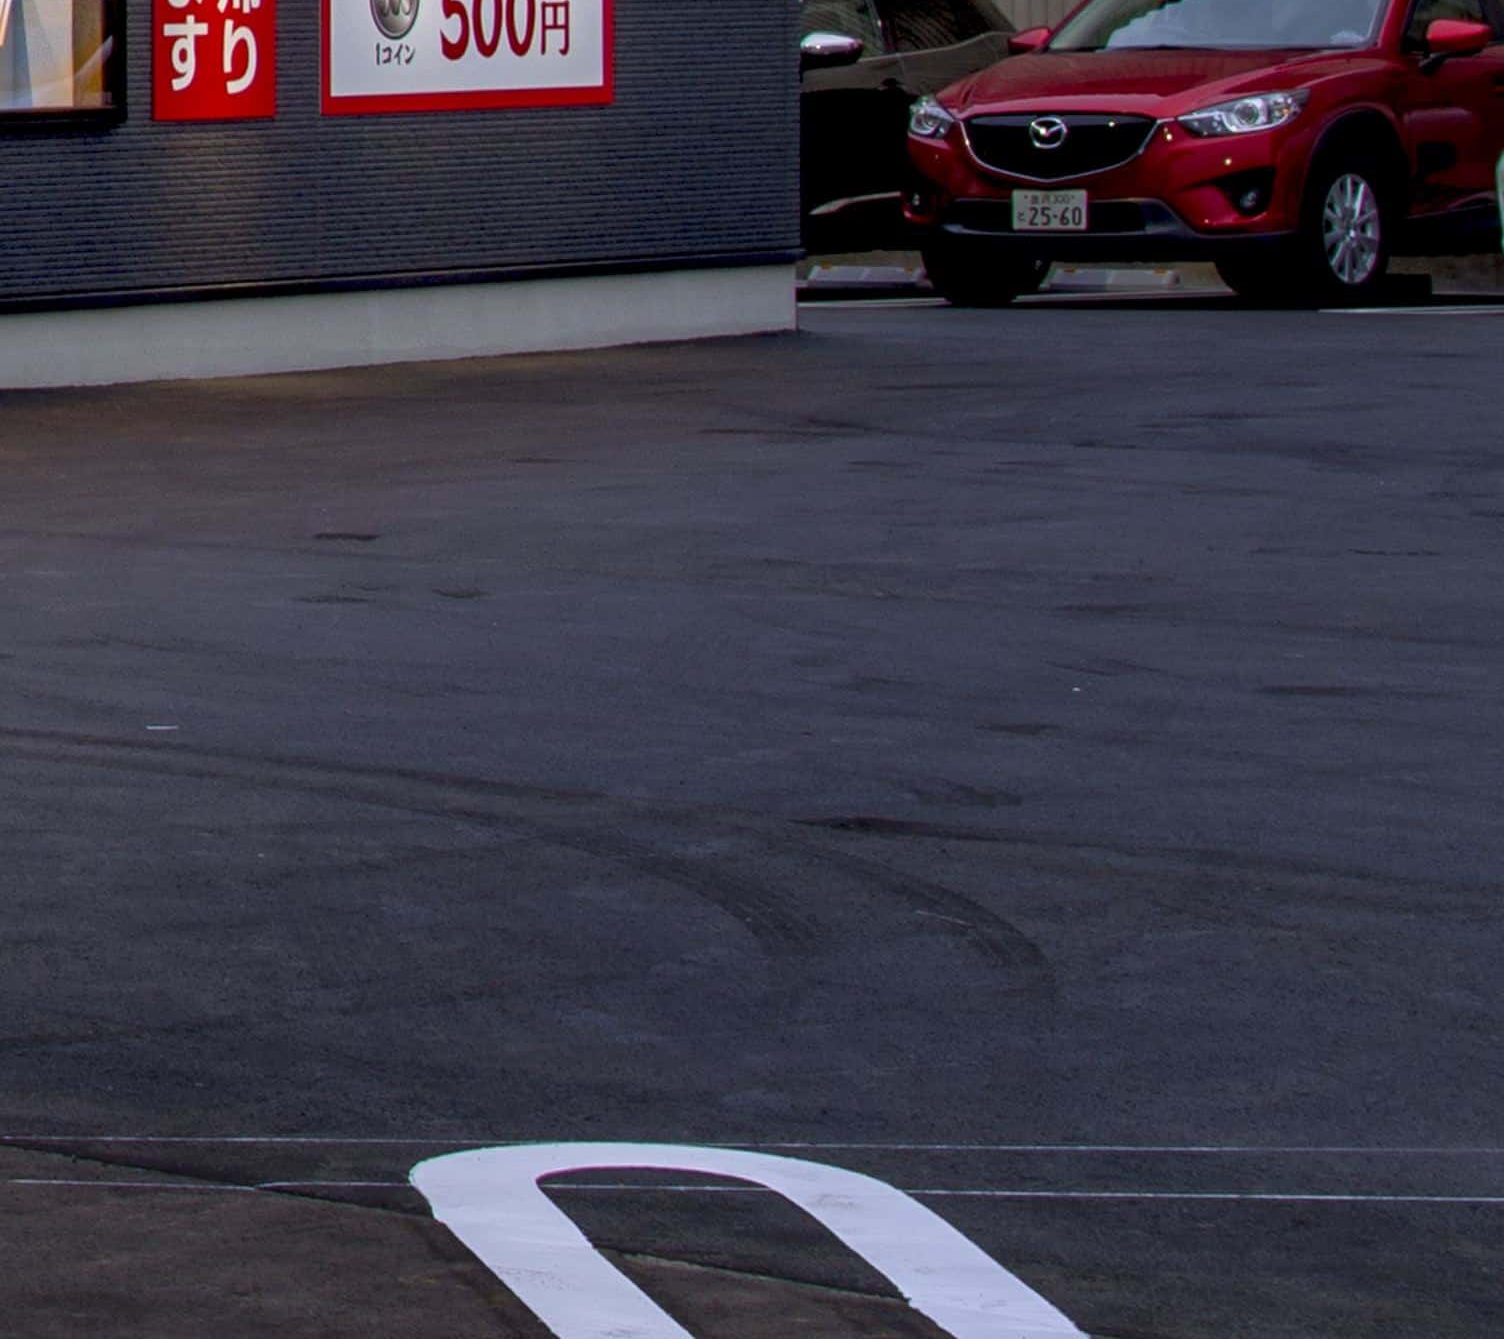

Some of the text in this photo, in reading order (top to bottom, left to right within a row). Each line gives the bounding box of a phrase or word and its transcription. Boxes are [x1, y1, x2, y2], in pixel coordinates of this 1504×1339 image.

[375, 42, 416, 67] 1コイン
[1029, 206, 1082, 226] 25-60
